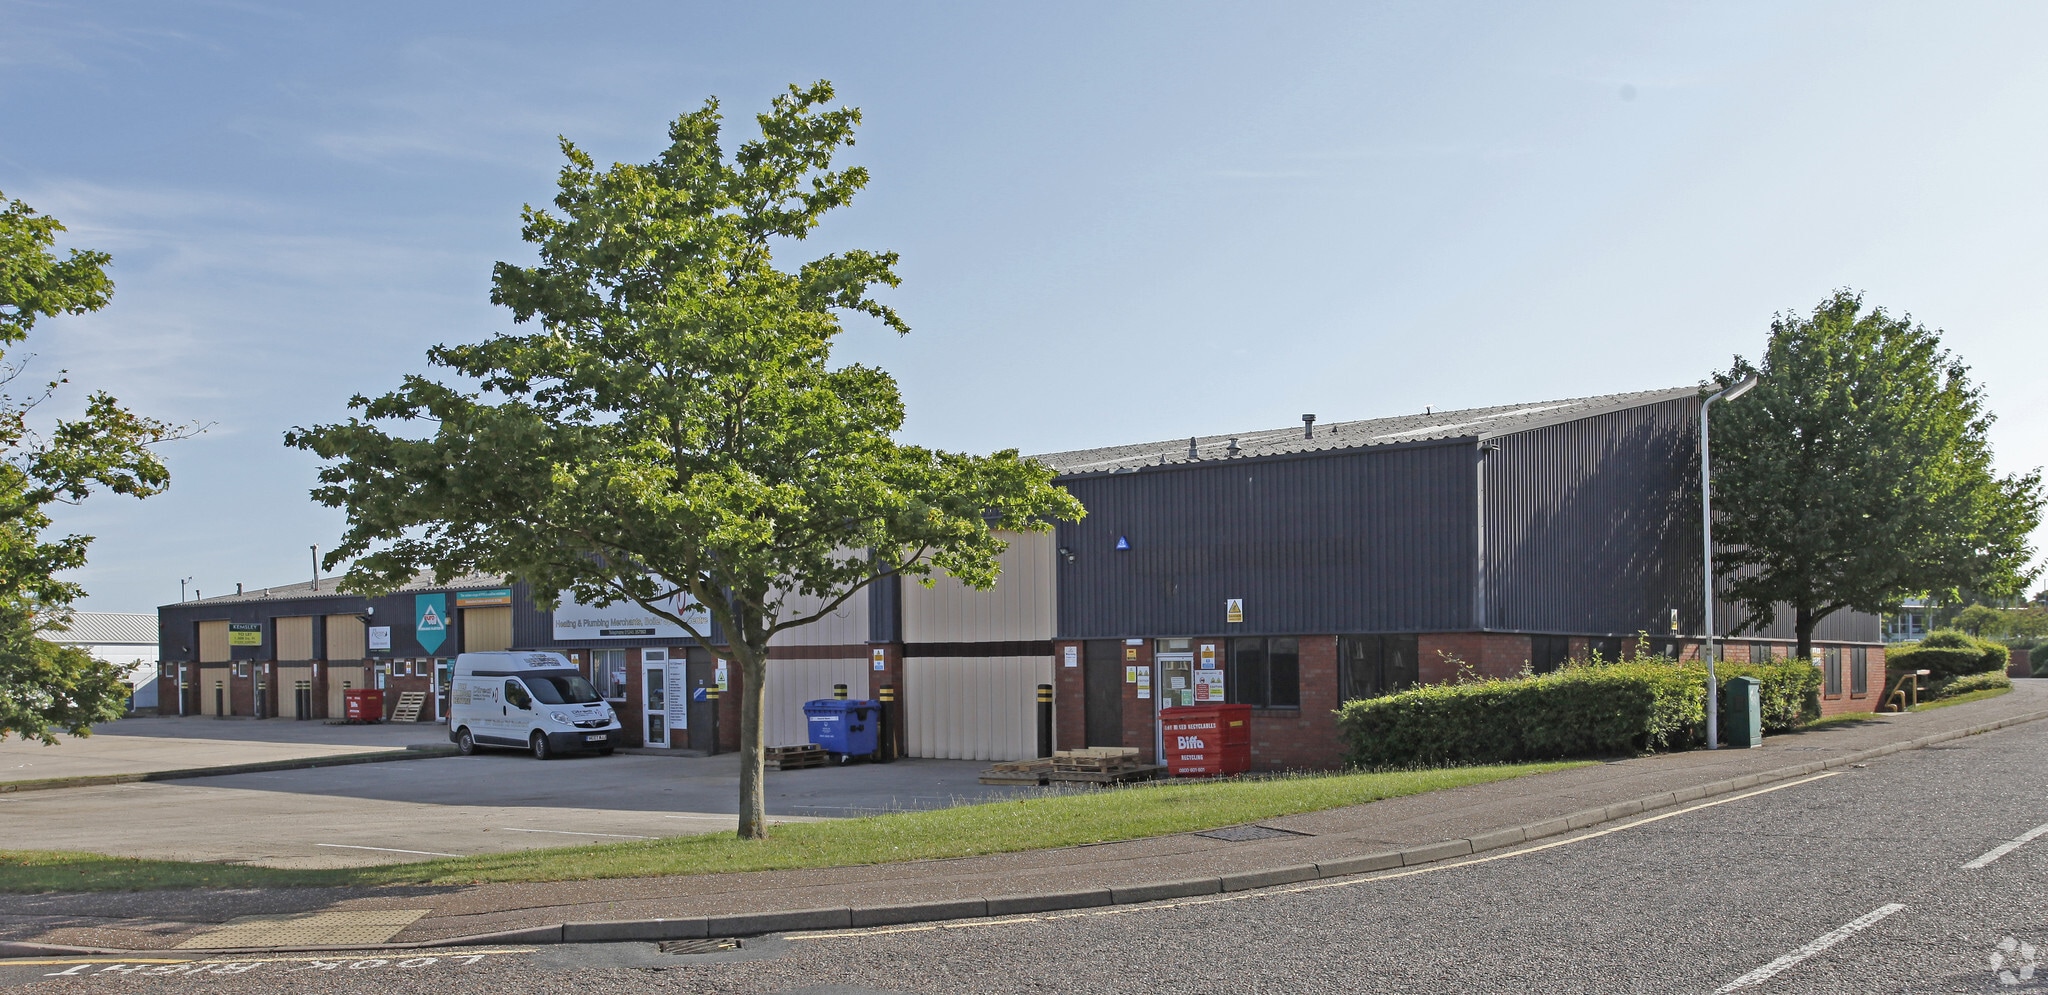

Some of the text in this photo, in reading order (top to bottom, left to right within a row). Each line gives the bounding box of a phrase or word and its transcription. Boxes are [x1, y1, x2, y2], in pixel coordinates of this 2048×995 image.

[555, 619, 576, 629] Heating
[577, 619, 582, 627] &
[583, 617, 609, 628] Plumbing
[610, 616, 643, 627] Merchants,
[1177, 735, 1205, 750] Biffa
[43, 955, 485, 976] LOOK RIGHT
